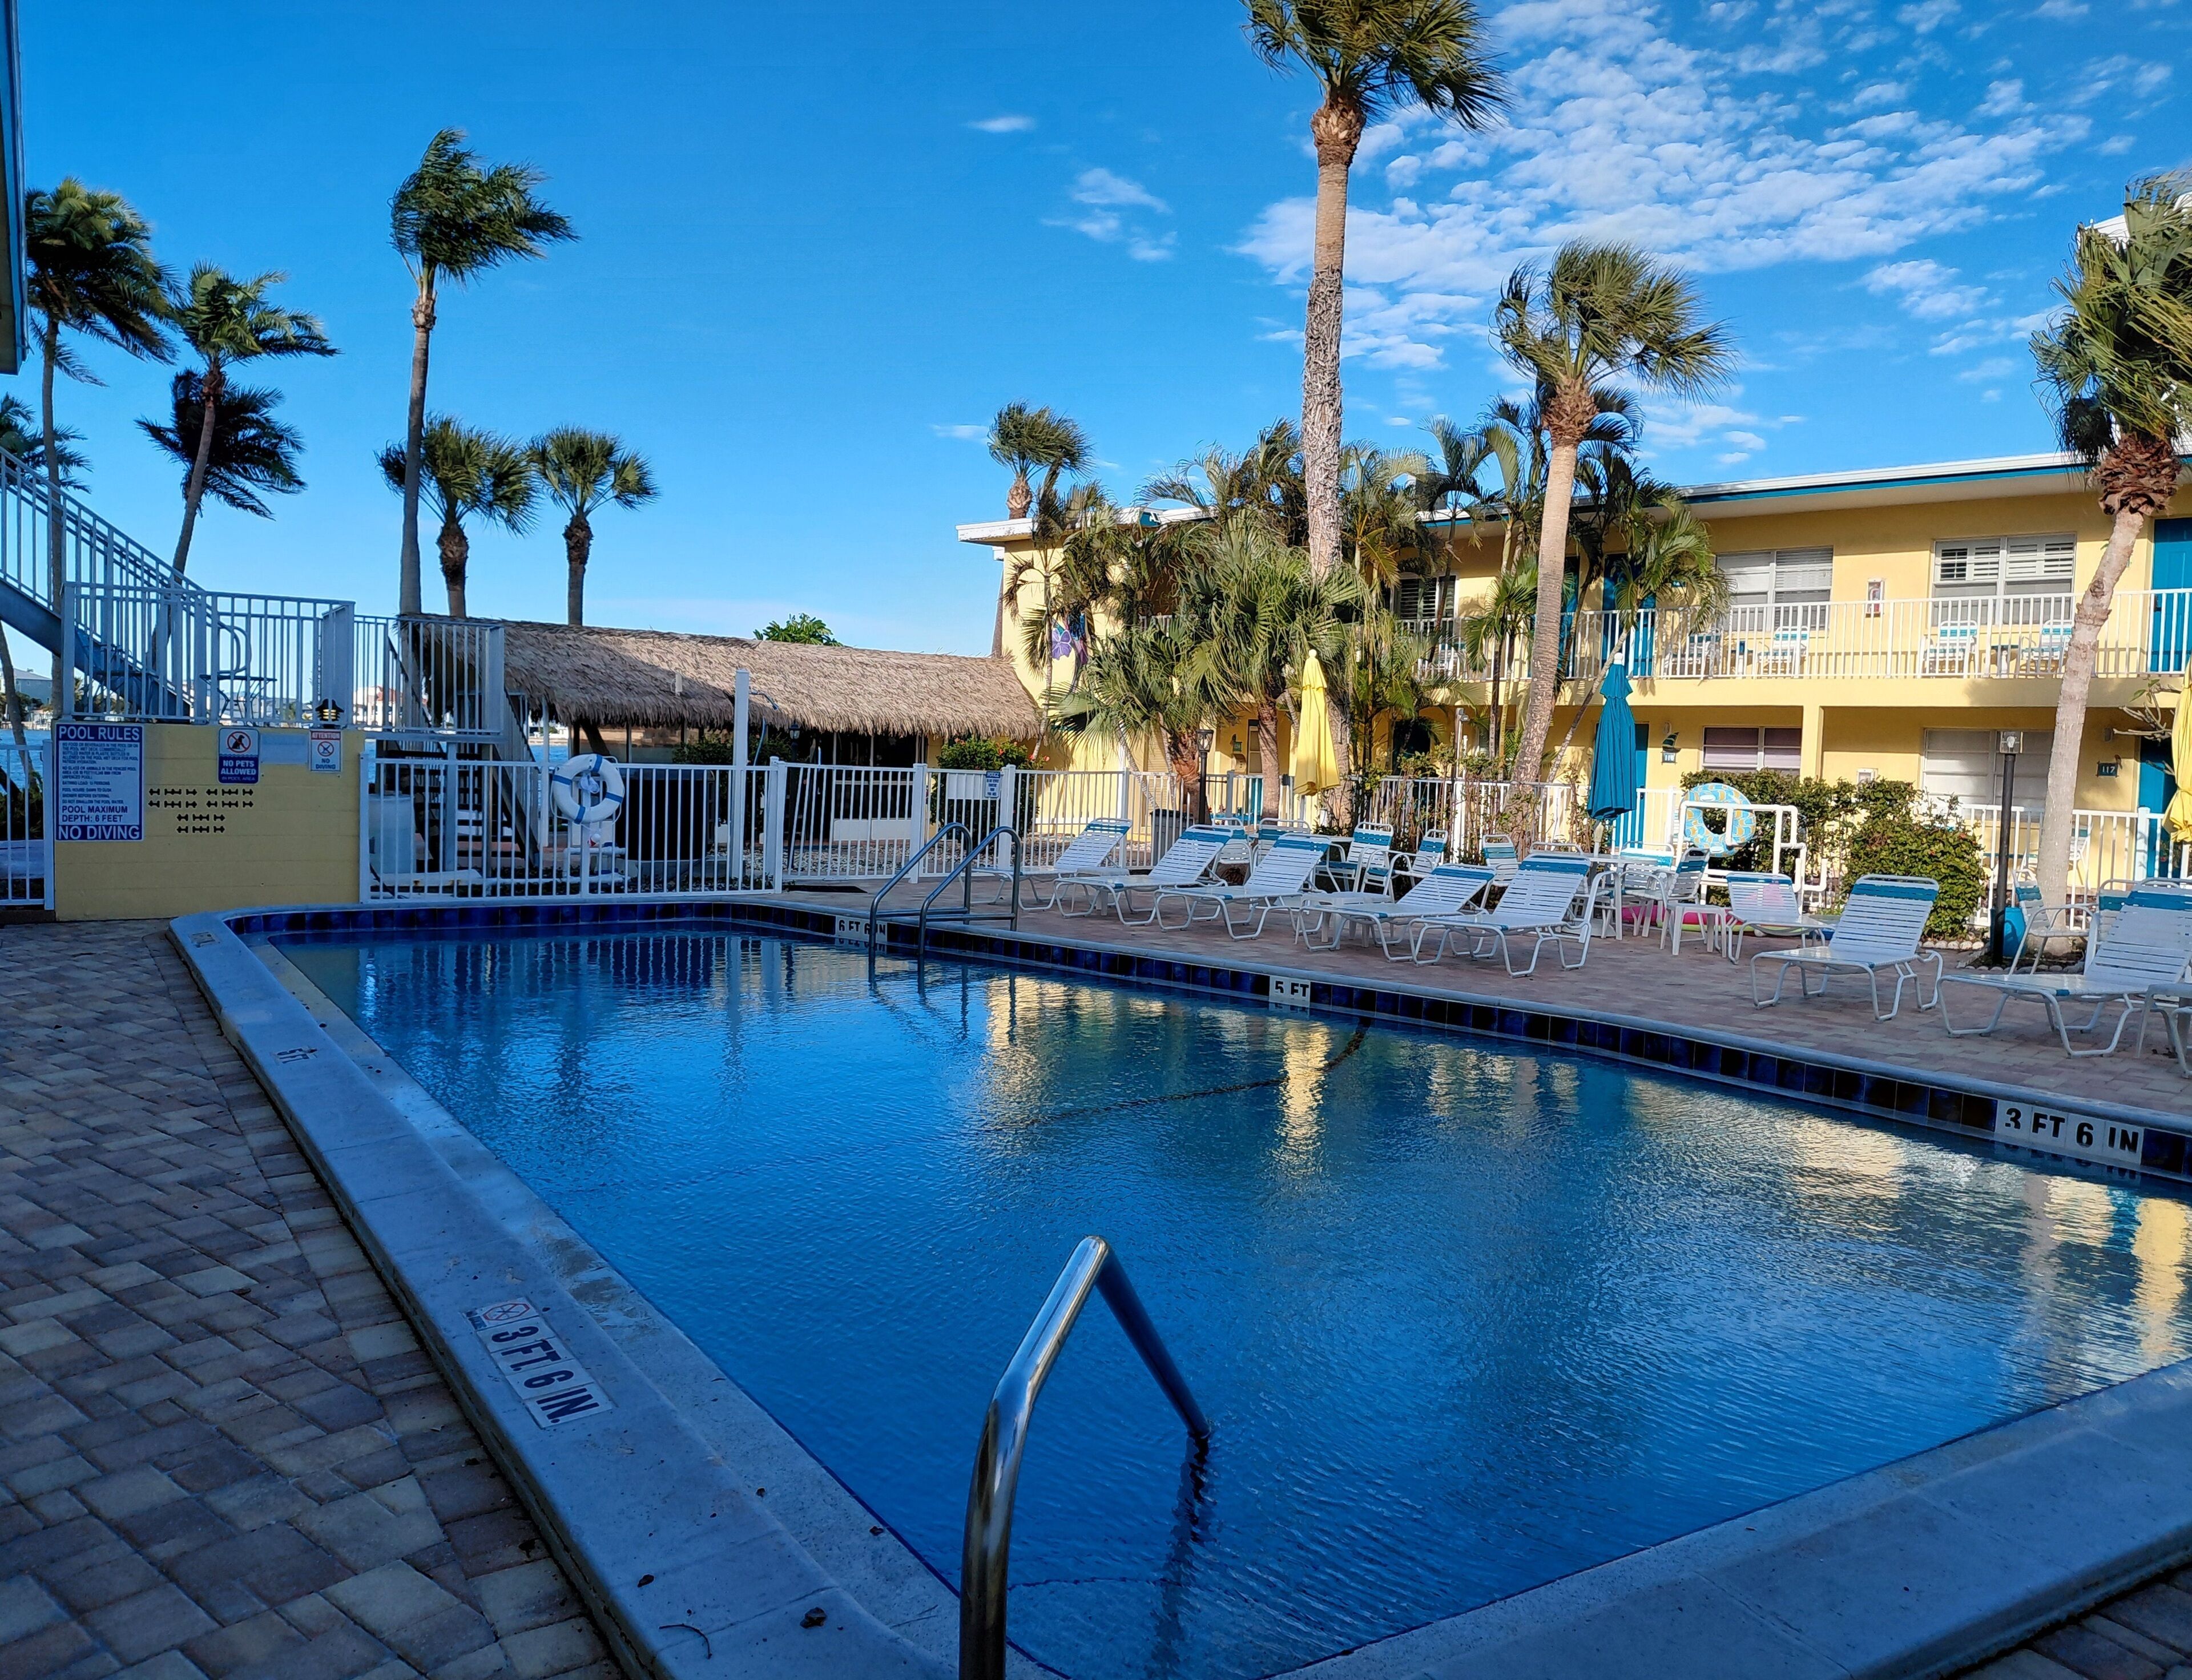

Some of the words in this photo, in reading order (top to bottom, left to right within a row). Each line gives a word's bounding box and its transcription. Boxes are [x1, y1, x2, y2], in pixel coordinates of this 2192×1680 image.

[59, 726, 94, 739] POOL
[98, 727, 139, 740] RULES
[59, 825, 81, 840] NO
[87, 825, 139, 840] DIVING
[849, 921, 860, 932] FT
[1275, 980, 1284, 993] 5
[1291, 982, 1309, 997] FT
[2005, 1107, 2021, 1129] 3
[2032, 1112, 2065, 1138] FT
[2076, 1122, 2094, 1148] 6
[2109, 1126, 2139, 1154] IN
[491, 1326, 539, 1343] 3
[501, 1339, 562, 1371] FT.
[523, 1370, 574, 1388] 6
[536, 1387, 599, 1424] IN.
